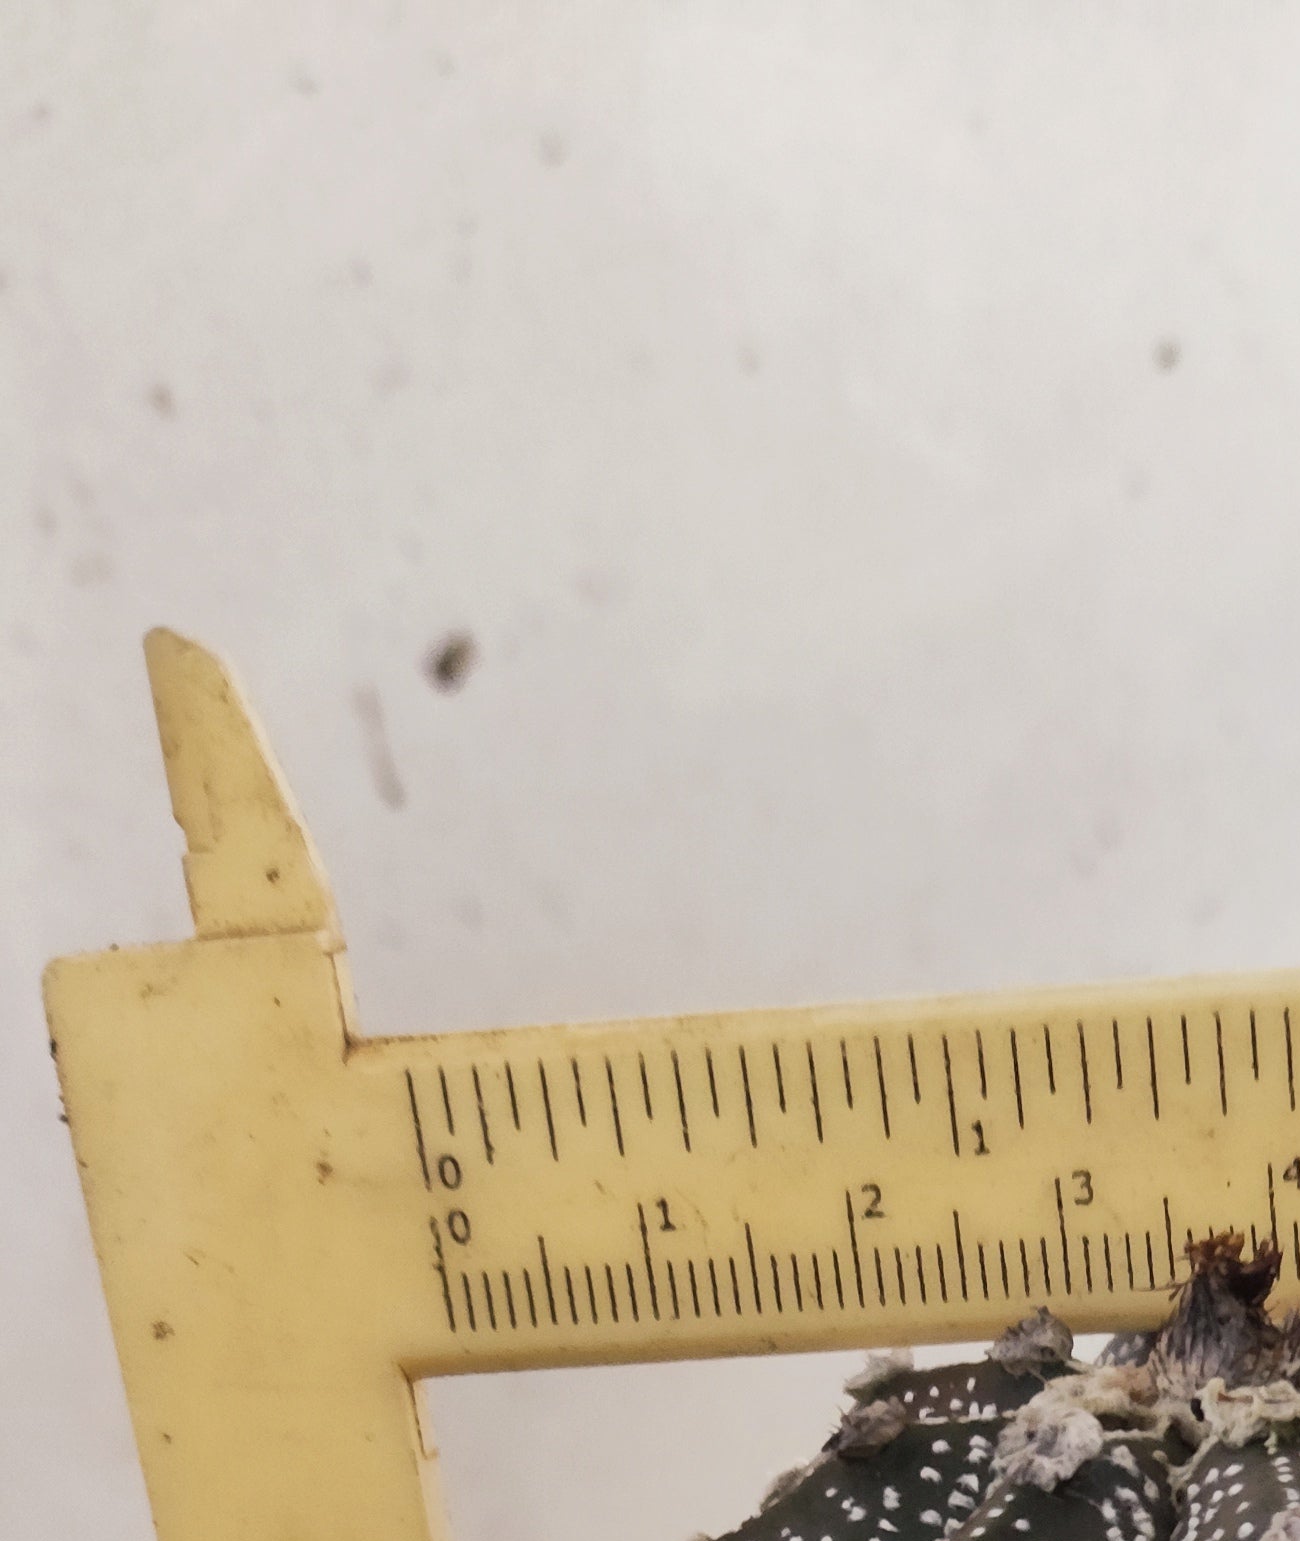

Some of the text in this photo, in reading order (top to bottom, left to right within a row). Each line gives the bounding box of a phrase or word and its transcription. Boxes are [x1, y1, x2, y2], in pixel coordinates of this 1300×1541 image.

[437, 1154, 463, 1191] 0
[971, 1119, 990, 1156] 1
[445, 1209, 471, 1246] 0
[656, 1197, 677, 1232] 1
[861, 1183, 885, 1220] 2
[1071, 1169, 1094, 1206] 3
